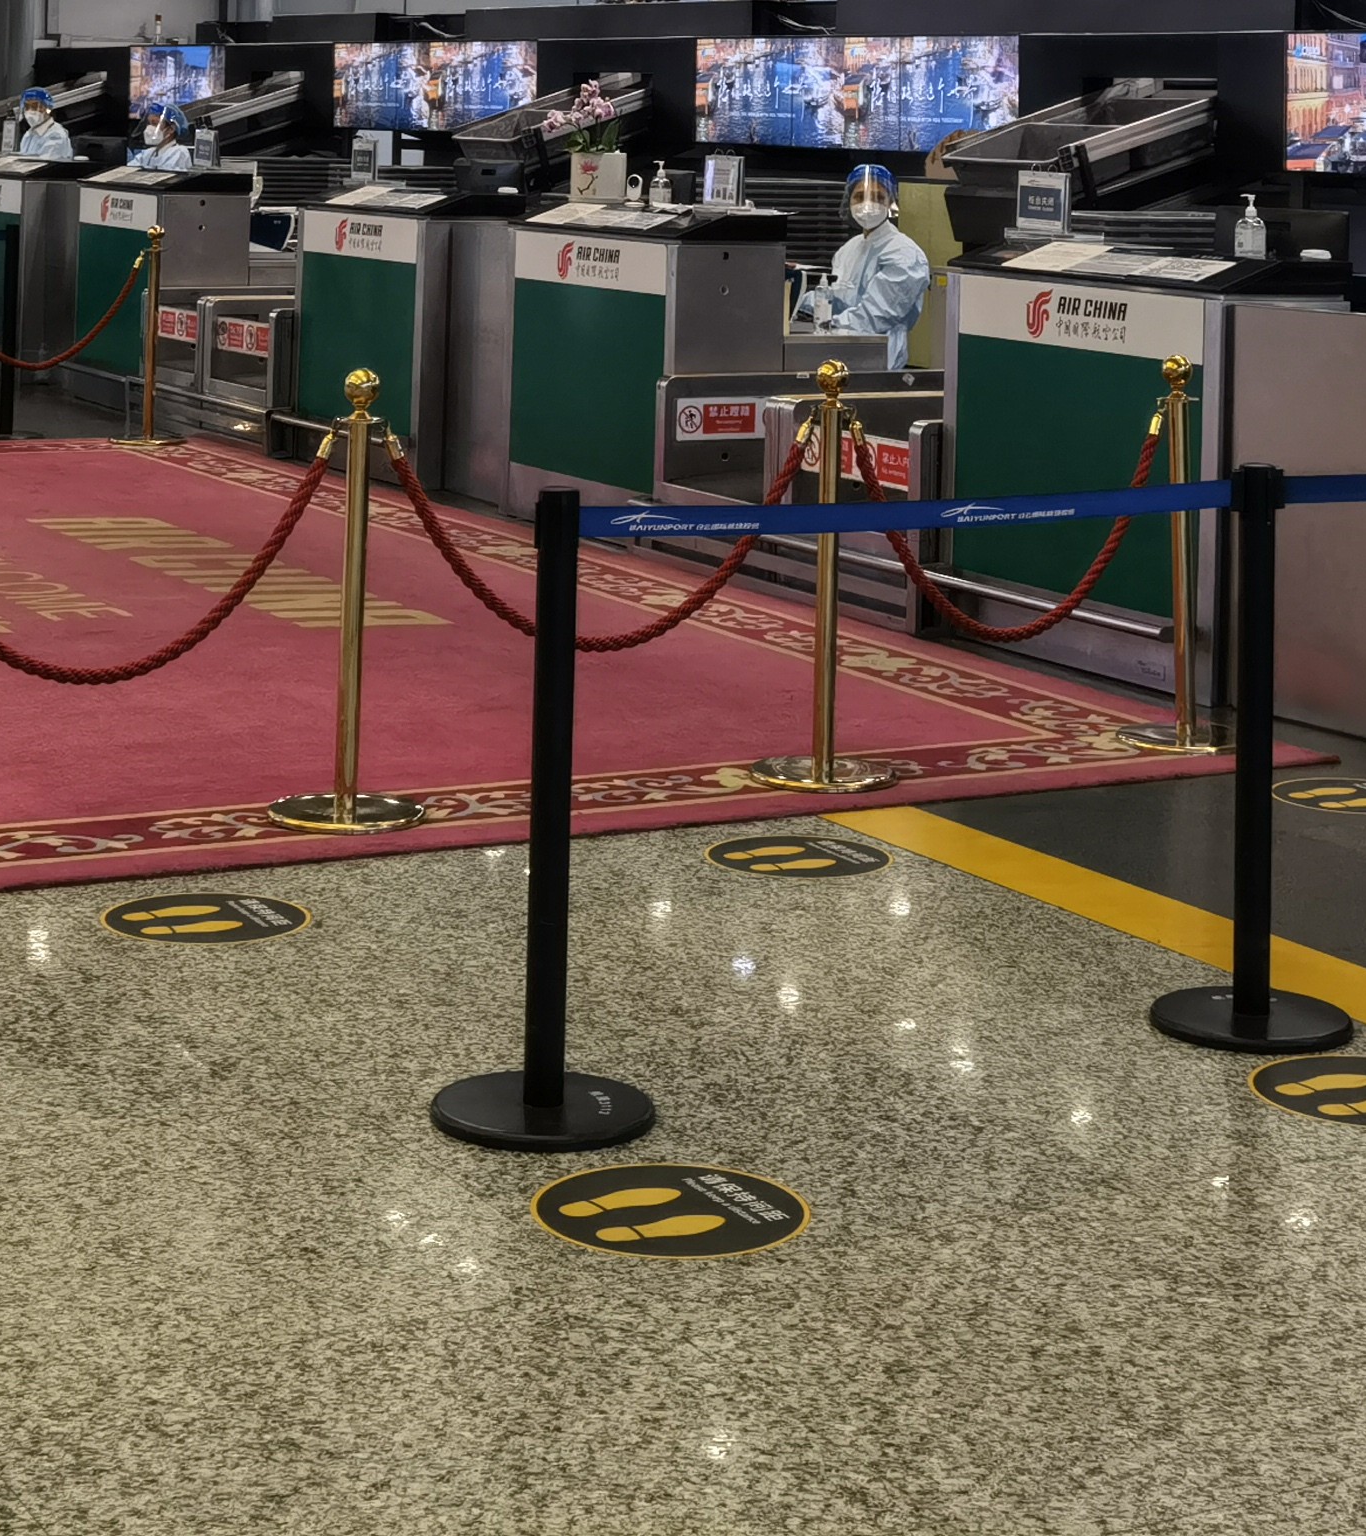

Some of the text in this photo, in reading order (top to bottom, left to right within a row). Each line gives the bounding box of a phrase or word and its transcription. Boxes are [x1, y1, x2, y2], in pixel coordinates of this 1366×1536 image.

[576, 246, 620, 264] AIR CHINA
[1057, 296, 1128, 321] AIR CHINA
[629, 523, 695, 532] BAIYUNPORT
[957, 513, 1016, 522] BAIYUNPORT
[26, 517, 454, 628] AIR CHINA
[697, 1173, 791, 1222] 请保持间距
